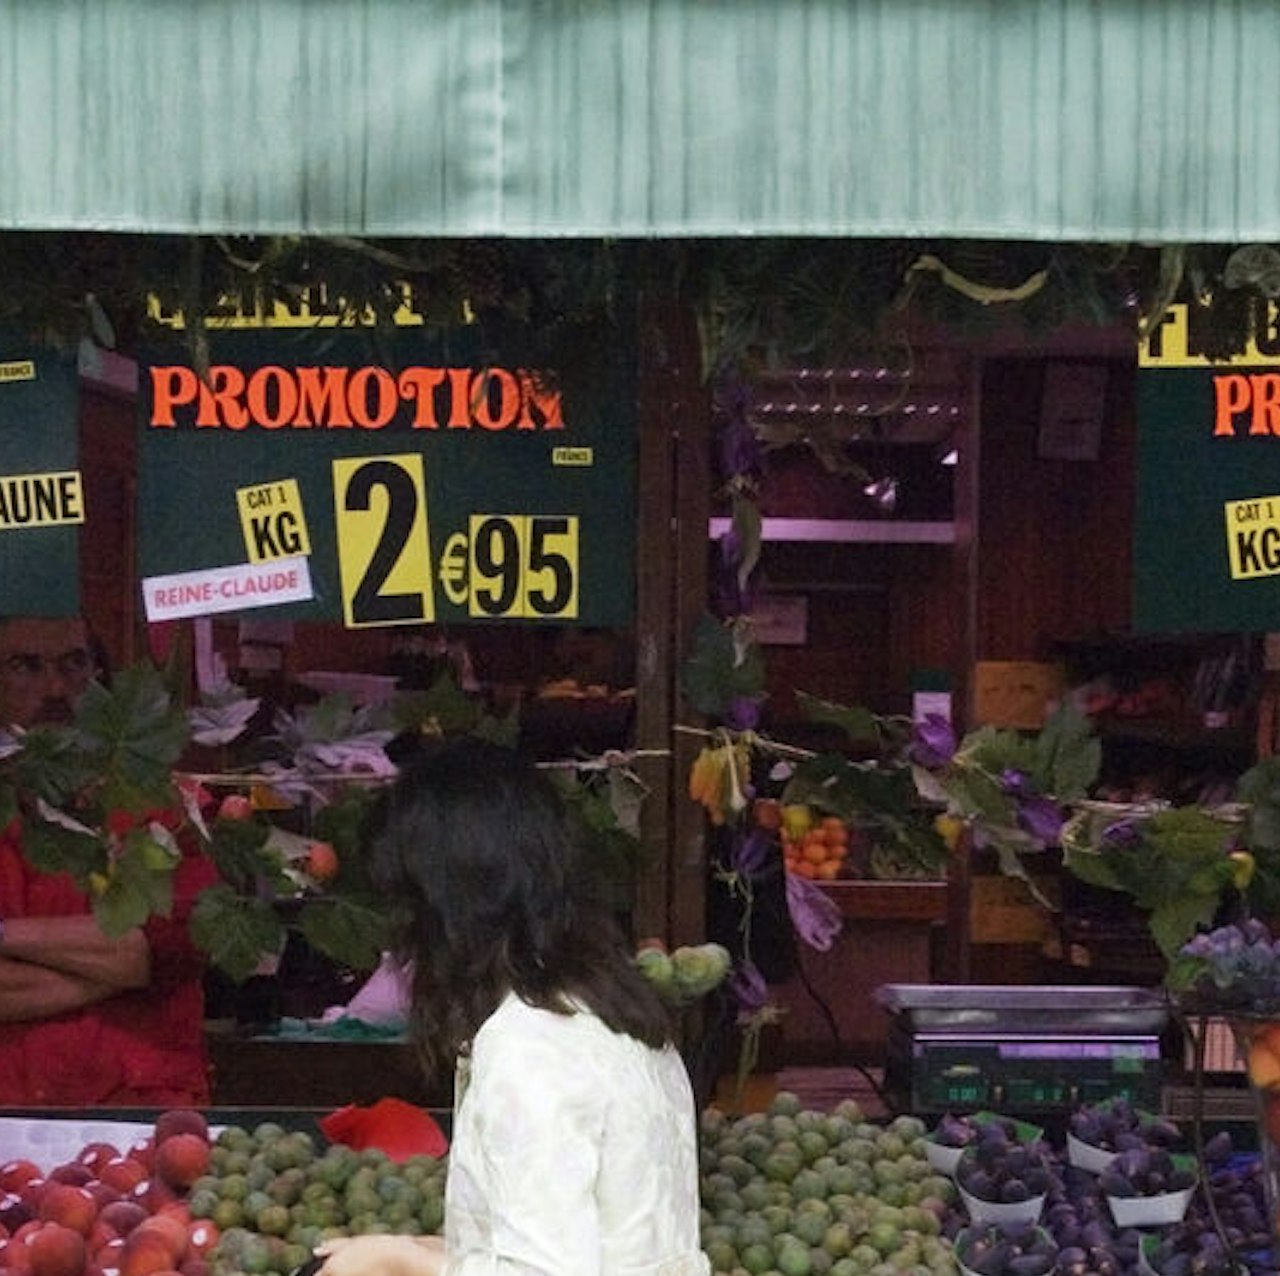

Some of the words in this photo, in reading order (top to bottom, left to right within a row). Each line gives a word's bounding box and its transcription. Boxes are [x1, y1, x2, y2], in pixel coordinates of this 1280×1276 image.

[150, 365, 564, 430] PROMOTION
[246, 489, 273, 508] CAT
[1235, 504, 1263, 522] CAT
[251, 511, 302, 559] KG
[154, 570, 299, 608] REINE-CLAUDE
